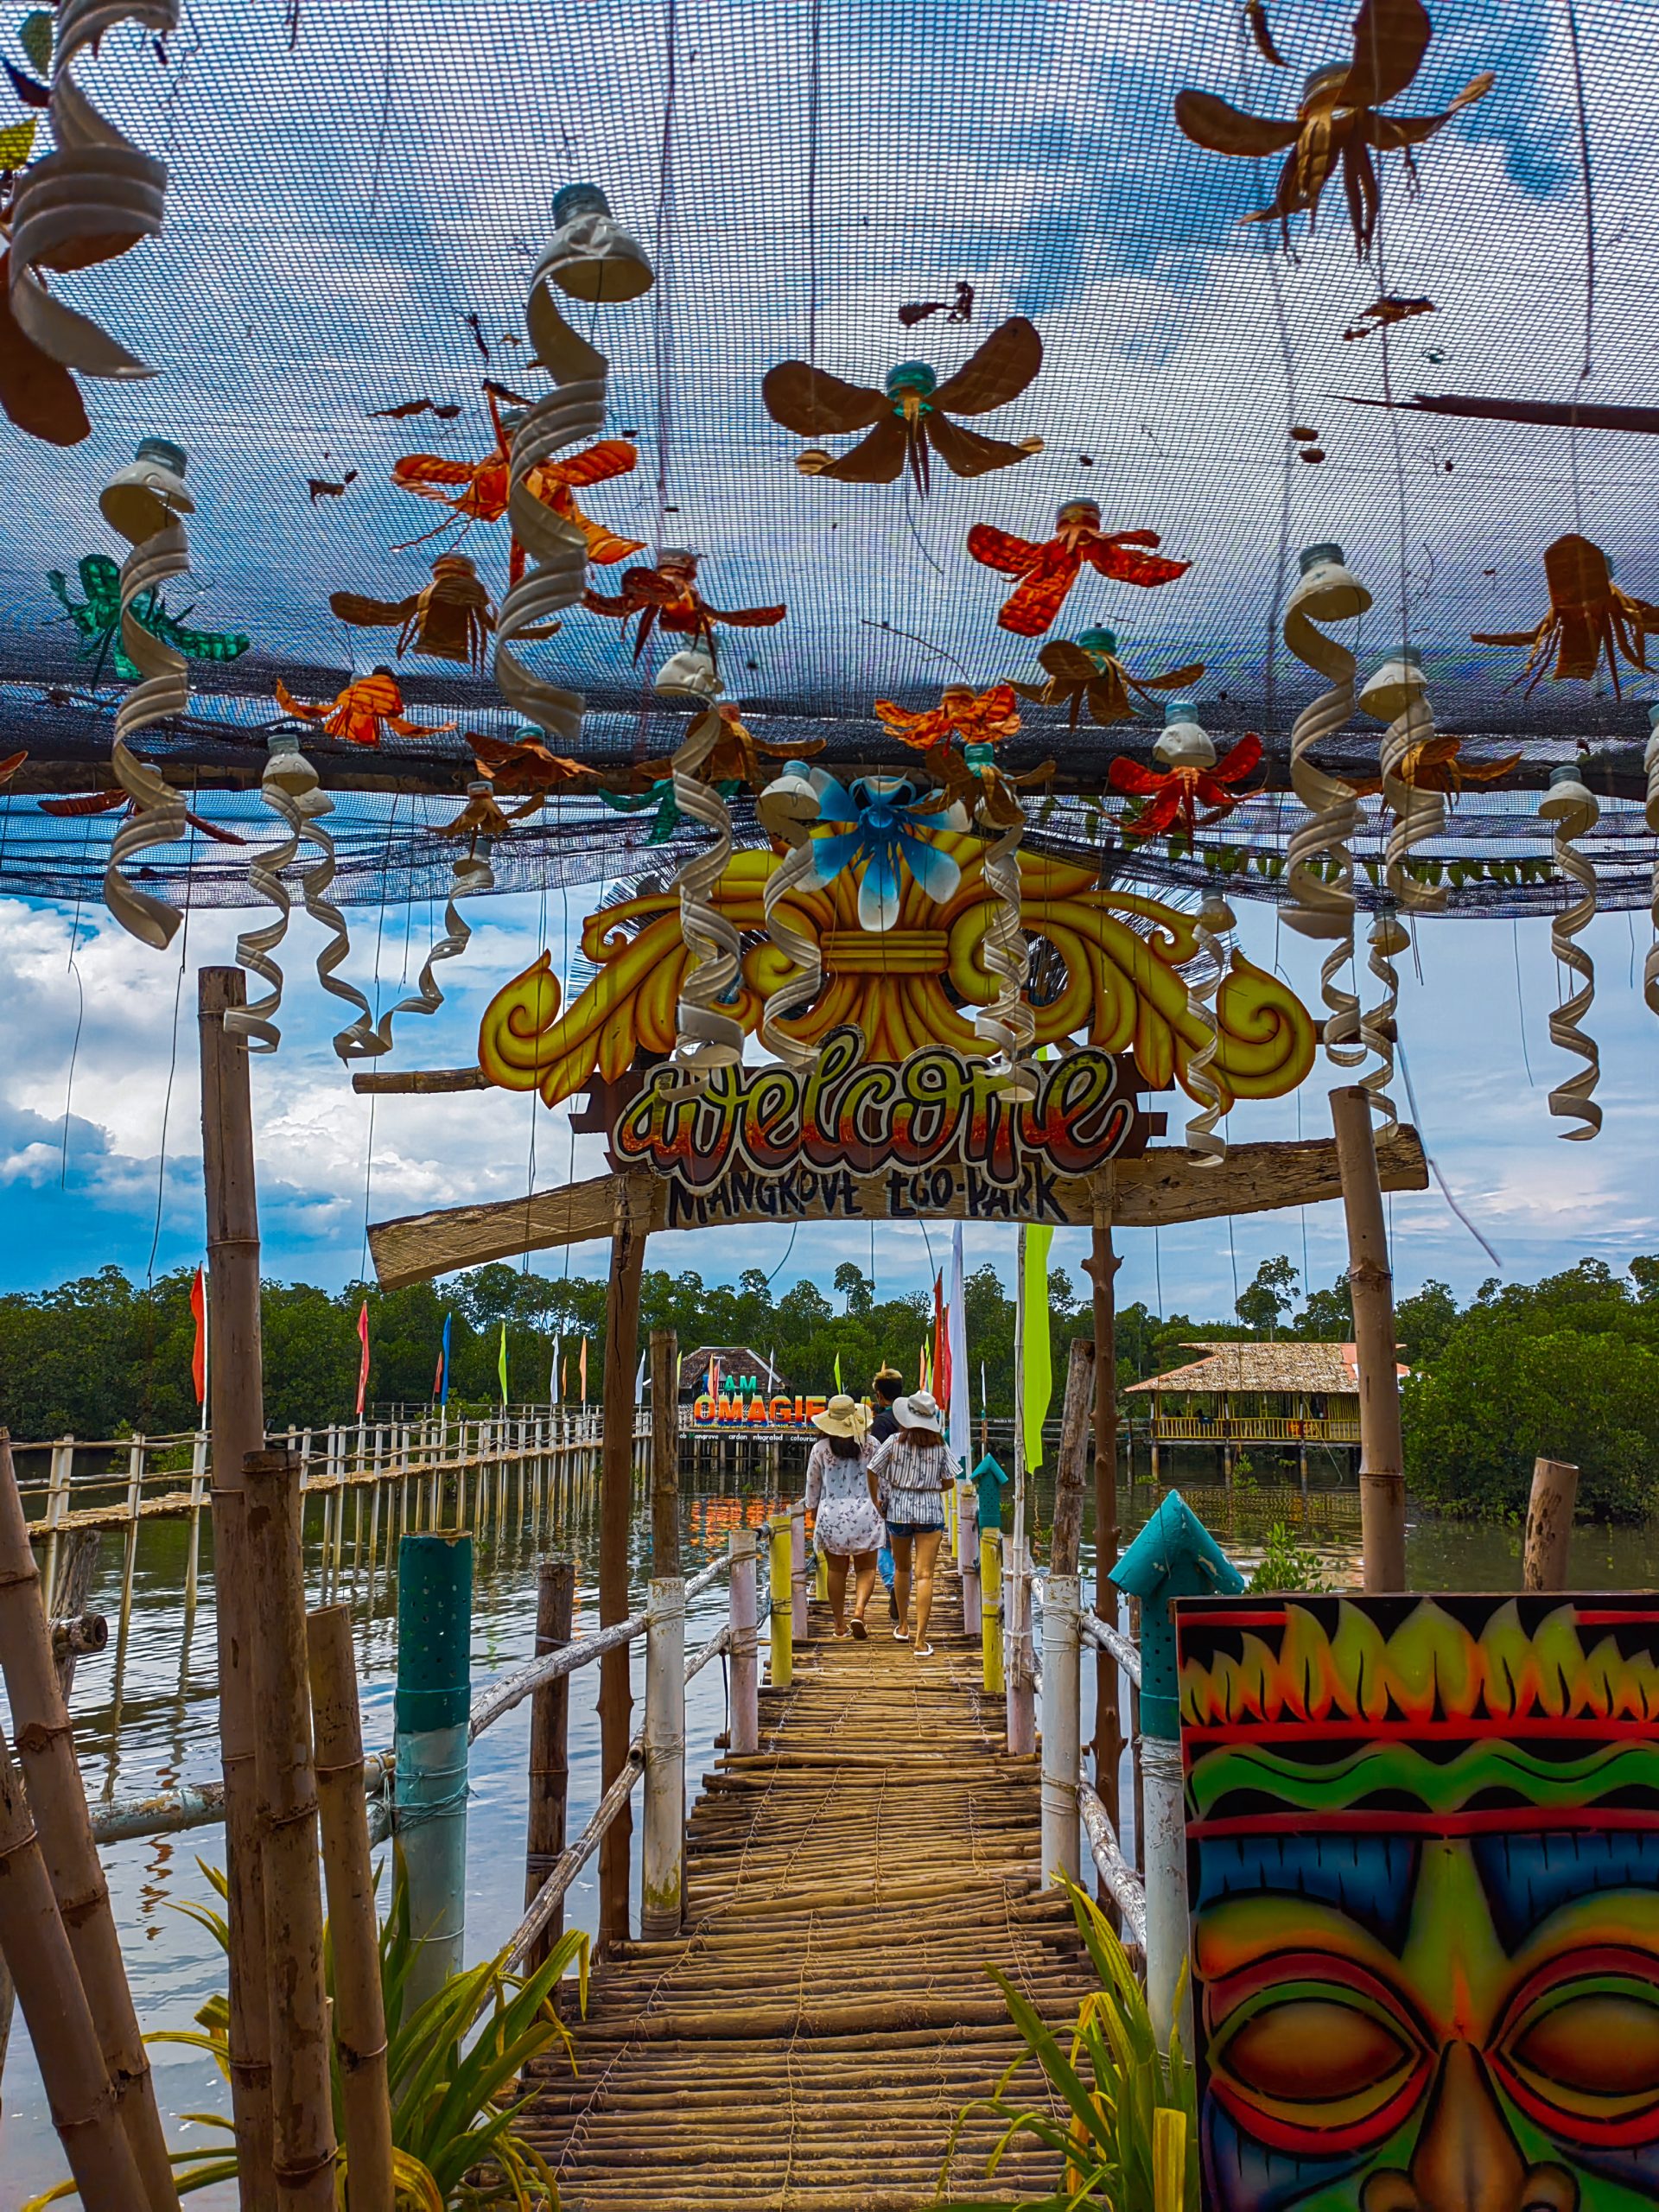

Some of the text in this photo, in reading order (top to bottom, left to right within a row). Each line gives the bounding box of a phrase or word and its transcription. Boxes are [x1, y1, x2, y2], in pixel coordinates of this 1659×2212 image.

[668, 1161, 1069, 1227] MANGROVE ECO-PARK
[724, 1375, 757, 1394] AM
